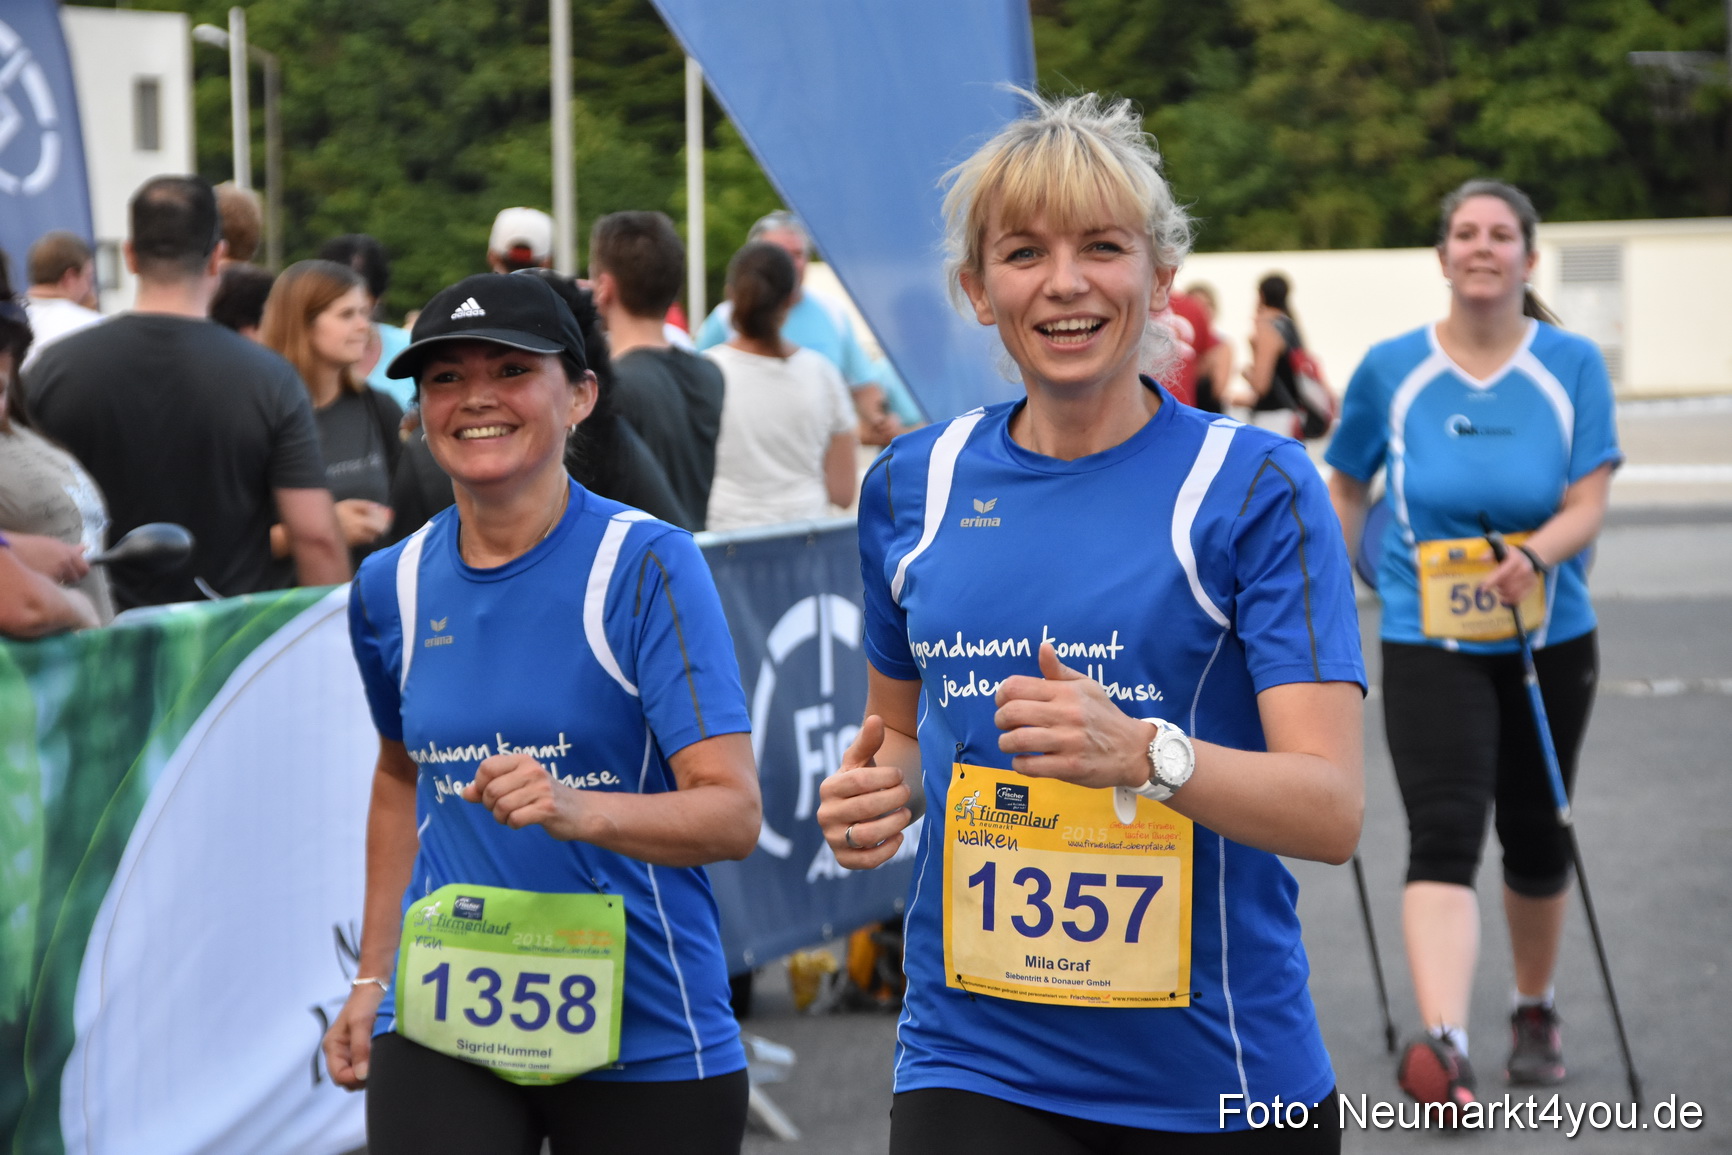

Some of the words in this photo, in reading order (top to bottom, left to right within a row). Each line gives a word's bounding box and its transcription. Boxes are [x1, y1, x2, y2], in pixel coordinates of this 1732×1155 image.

[450, 308, 486, 320] adidas
[960, 515, 1001, 528] erima
[424, 634, 453, 648] erima
[979, 805, 1059, 829] firmenlauf
[979, 822, 1013, 830] neumarkt
[1061, 826, 1108, 841] 2015
[957, 829, 1018, 851] walken
[968, 861, 1164, 943] 1357
[437, 913, 511, 936] firmenlauf
[512, 932, 553, 947] 2015
[1025, 955, 1054, 970] Mila
[1057, 957, 1091, 972] Graf
[1005, 971, 1042, 983] Siebentritt
[1051, 977, 1085, 986] Donauer
[1086, 978, 1111, 987] GmbH
[422, 962, 597, 1034] 1358
[456, 1039, 494, 1055] Sigrid
[498, 1043, 552, 1058] Hummel
